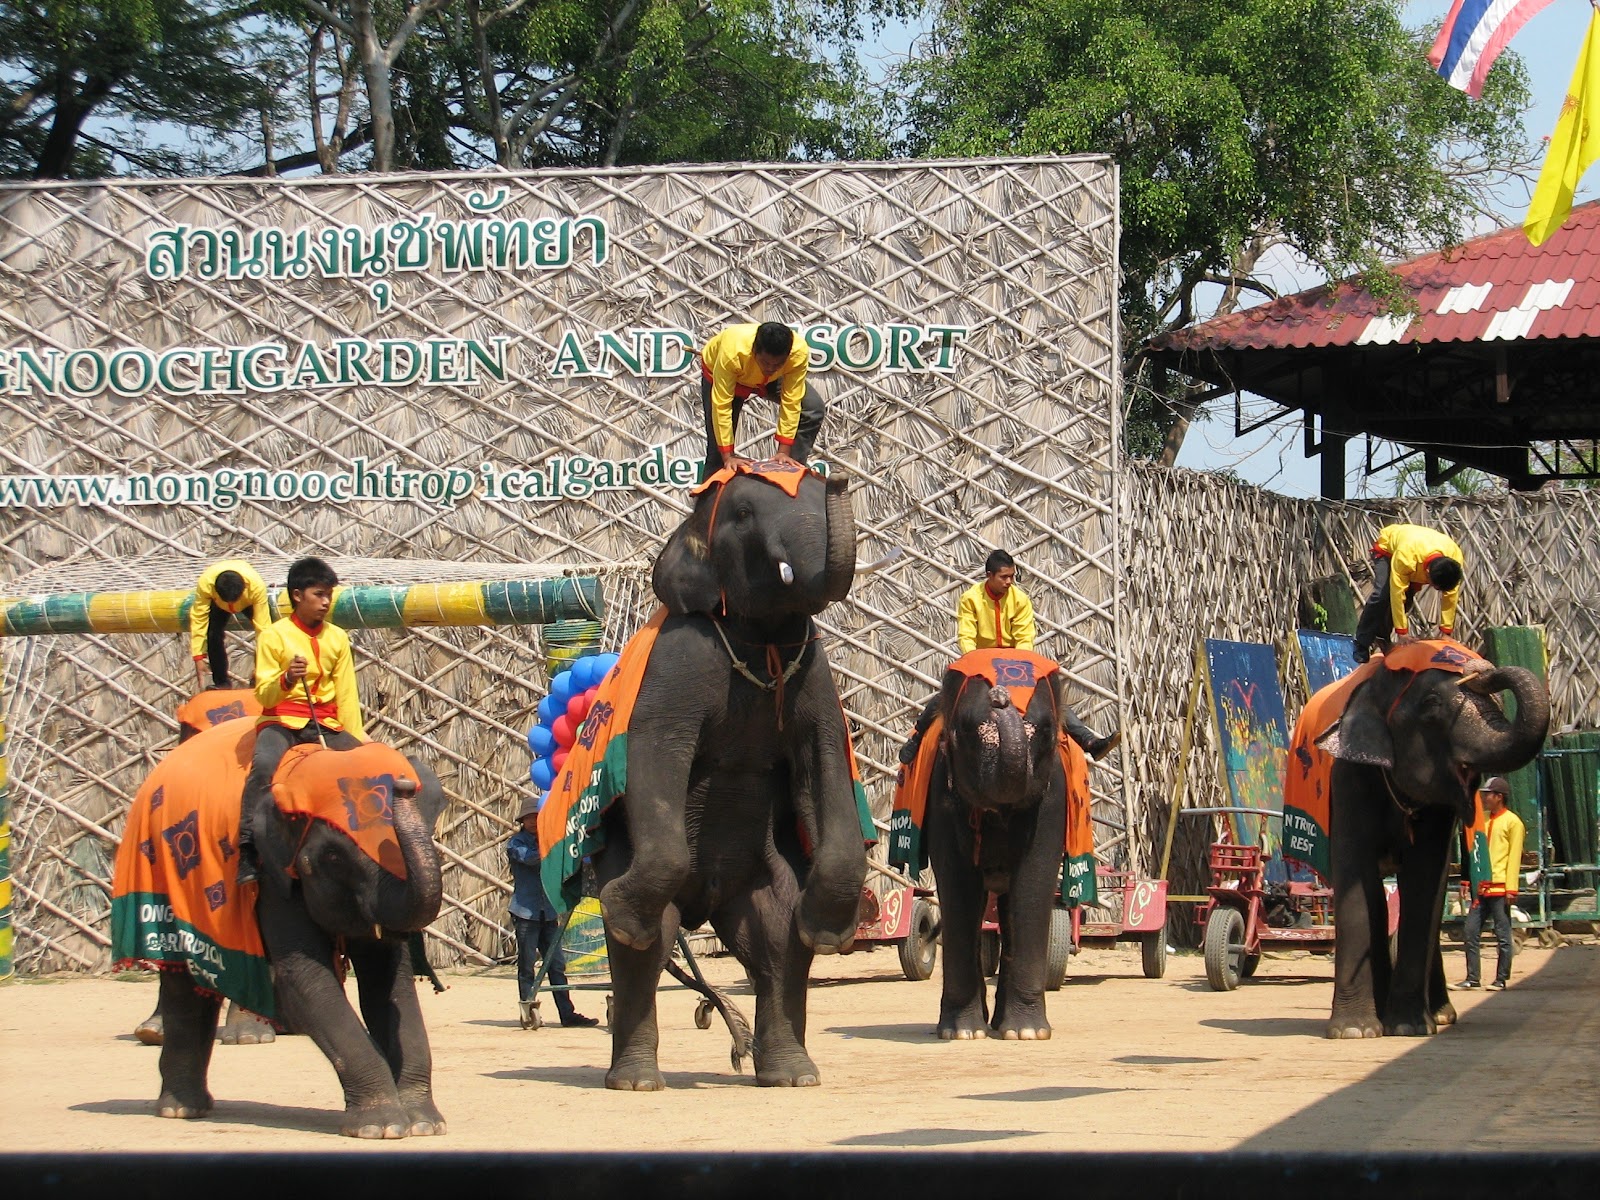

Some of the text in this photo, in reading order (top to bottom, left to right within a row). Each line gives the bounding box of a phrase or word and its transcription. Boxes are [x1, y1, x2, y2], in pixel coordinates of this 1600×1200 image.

[147, 187, 608, 312] สวนนงนุชพัทยา
[0, 323, 967, 395] NOOCHGARDEN AND SORT
[1290, 835, 1315, 856] REST
